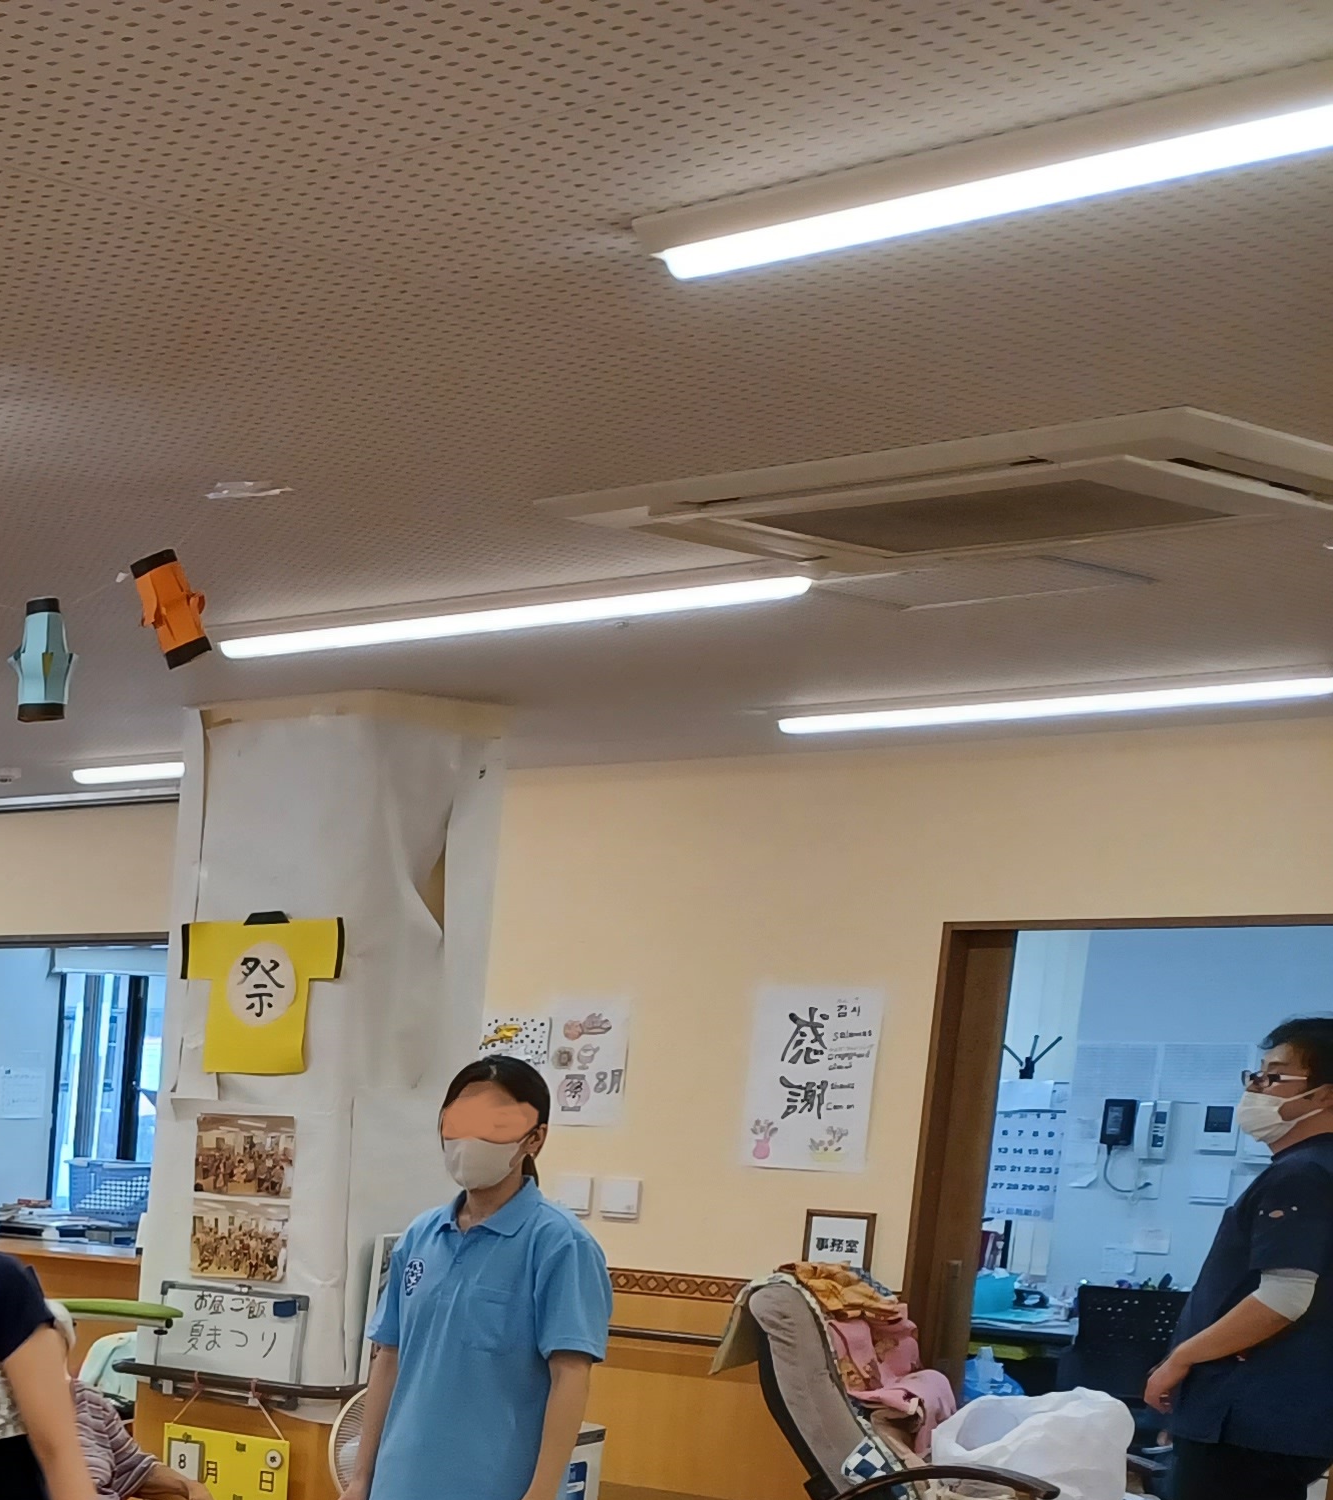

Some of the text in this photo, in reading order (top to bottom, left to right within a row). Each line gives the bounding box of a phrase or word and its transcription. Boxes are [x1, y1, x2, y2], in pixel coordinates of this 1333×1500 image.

[237, 957, 285, 1018] 祭
[780, 1007, 829, 1119] 感謝
[594, 1069, 623, 1095] 8月
[816, 1237, 859, 1253] 事務室
[195, 1291, 267, 1319] お昼ご飯
[183, 1319, 277, 1358] 夏まつり
[259, 1470, 275, 1492] 日
